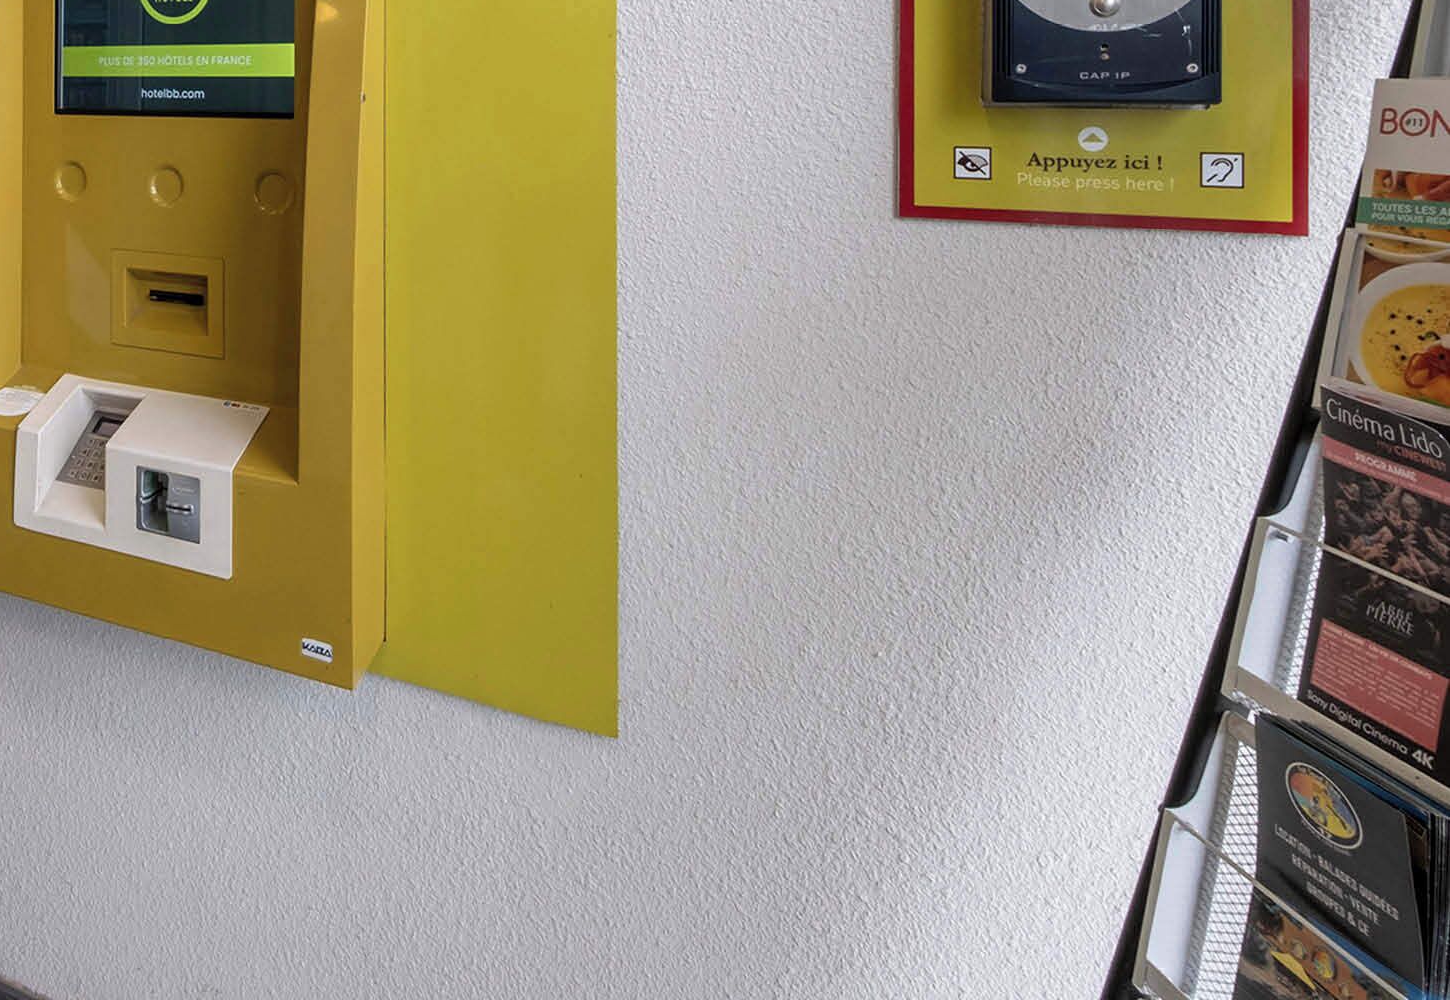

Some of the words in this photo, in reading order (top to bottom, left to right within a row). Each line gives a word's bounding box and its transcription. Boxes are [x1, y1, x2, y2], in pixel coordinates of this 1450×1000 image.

[196, 56, 209, 66] EN
[211, 55, 252, 66] FRANCE
[1079, 71, 1110, 80] CAP
[1114, 71, 1130, 80] IP
[141, 88, 206, 100] hotelbb.com
[1026, 152, 1118, 174] Appuyez
[1123, 152, 1149, 171] ici
[1017, 172, 1070, 189] Please
[1074, 177, 1121, 193] press
[1125, 175, 1164, 191] here
[1415, 204, 1438, 216] LES
[1325, 397, 1396, 443] Cinéma
[1399, 422, 1443, 459] Lido
[1362, 720, 1408, 756] Cinema
[1412, 745, 1435, 771] 4K
